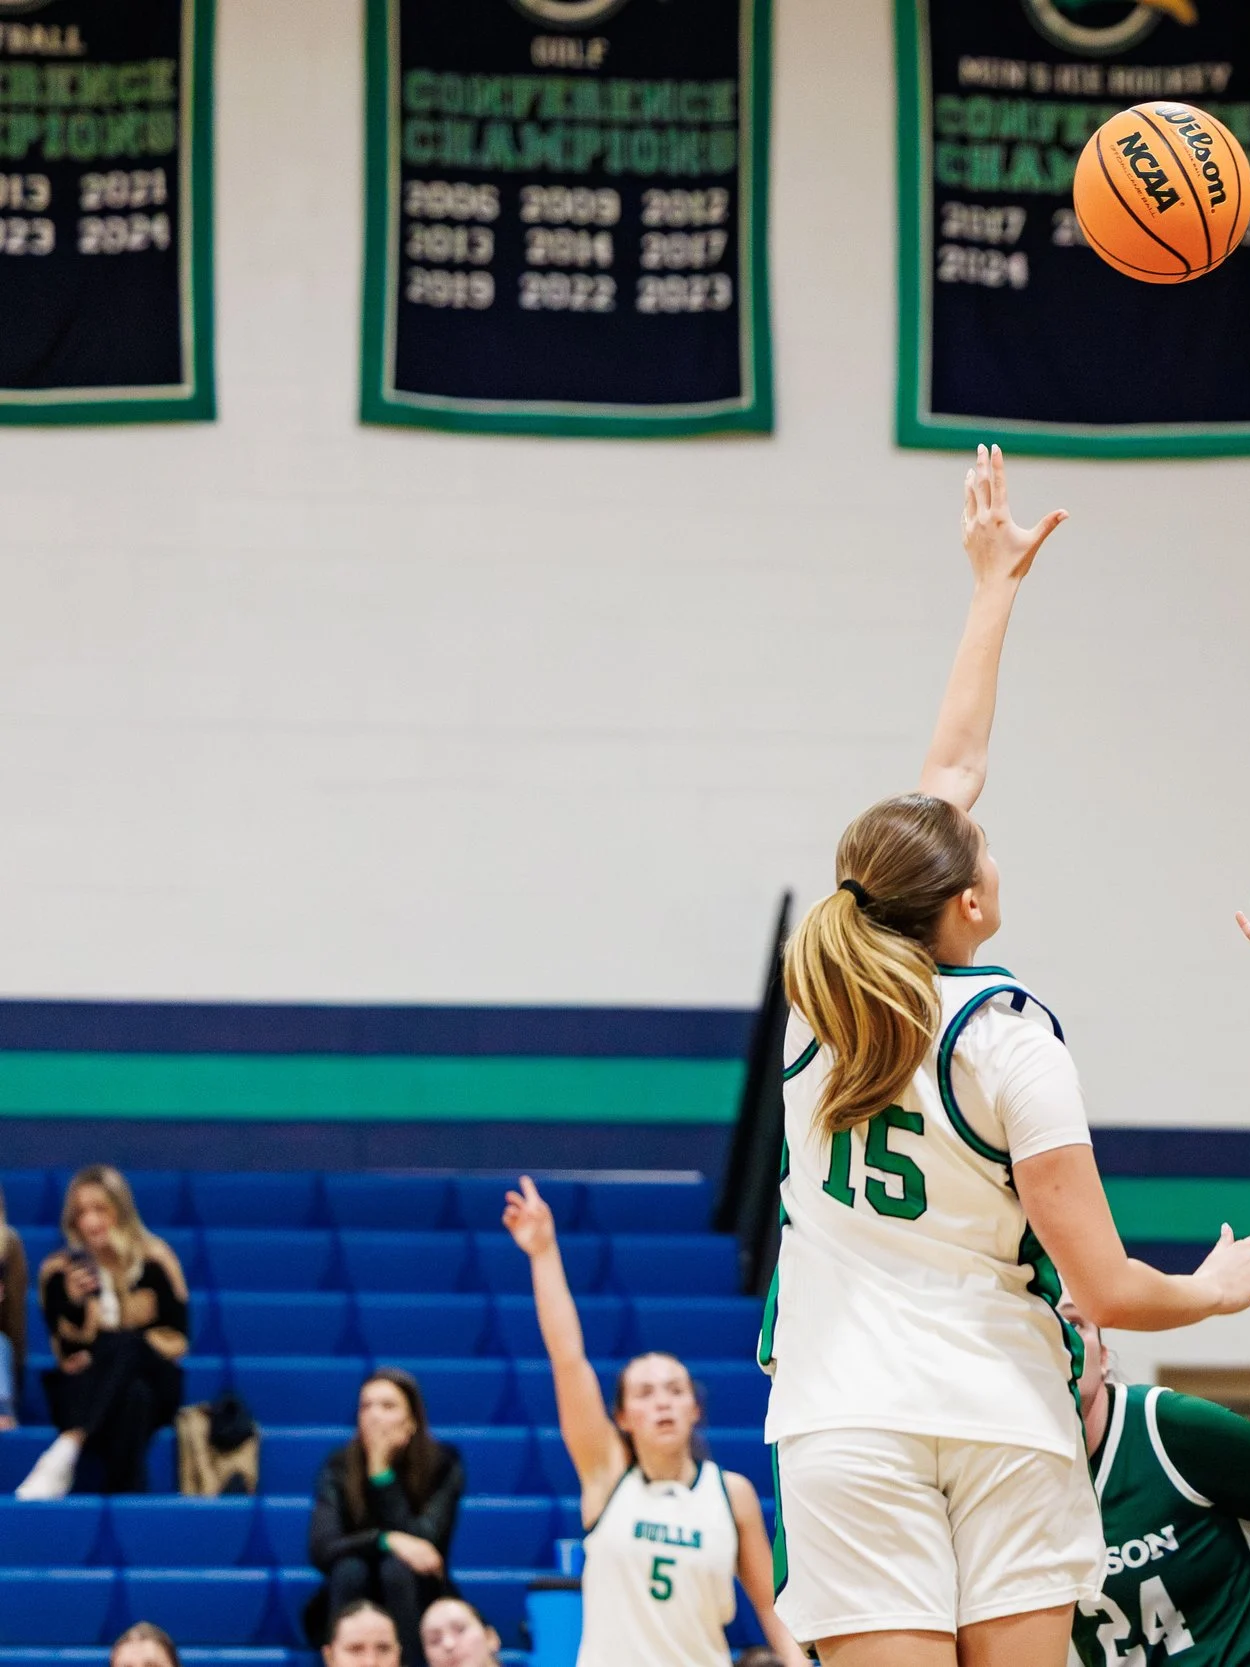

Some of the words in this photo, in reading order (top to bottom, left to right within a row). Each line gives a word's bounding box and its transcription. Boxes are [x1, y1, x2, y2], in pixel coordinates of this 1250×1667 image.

[0, 23, 86, 56] BALL
[404, 69, 735, 121] CONFERENCE
[404, 119, 735, 176] CHAMPIONS
[1116, 131, 1181, 215] NCAA
[1155, 102, 1226, 208] Wilson
[822, 1103, 927, 1221] 15
[633, 1519, 703, 1550] BULLS
[1105, 1524, 1179, 1576] SON
[650, 1556, 676, 1601] 5
[1078, 1576, 1195, 1667] 24
